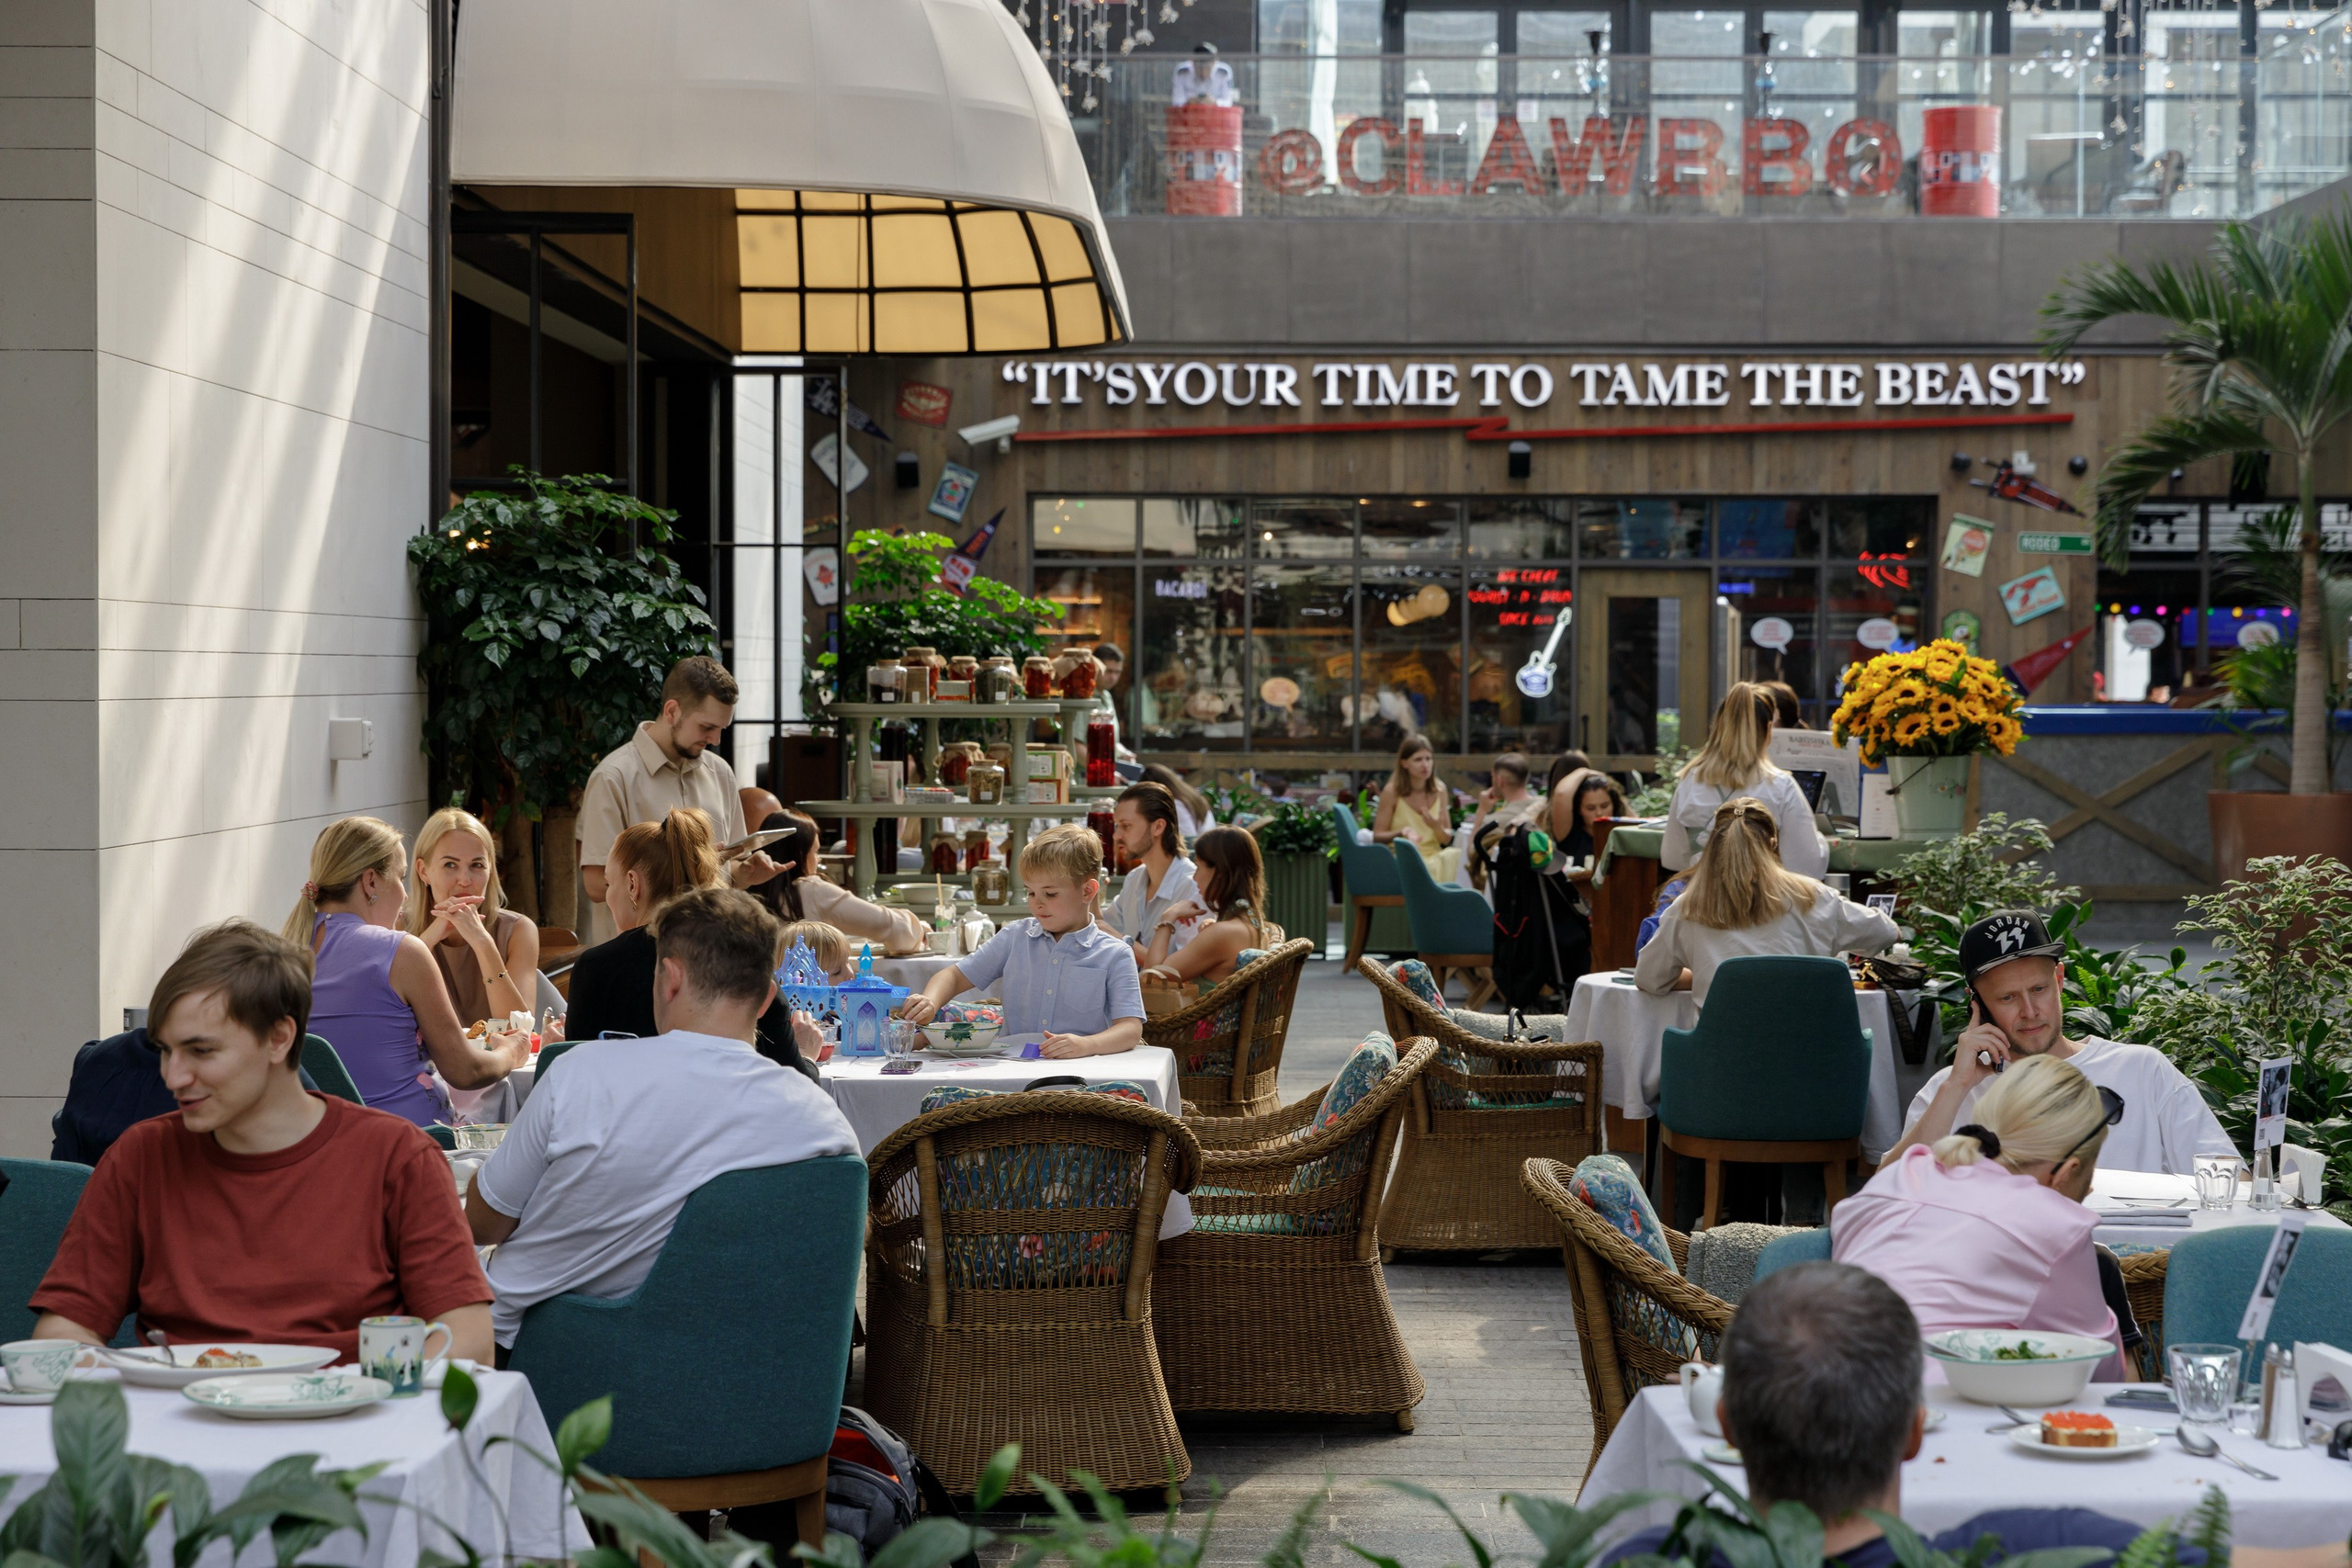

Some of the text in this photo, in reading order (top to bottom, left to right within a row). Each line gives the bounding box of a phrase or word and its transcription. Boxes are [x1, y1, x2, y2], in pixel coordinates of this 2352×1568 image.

[1312, 362, 1462, 407] TIME
[1470, 362, 1555, 408] TO
[1569, 362, 1730, 407] TAME
[1739, 362, 1866, 407] THE
[1984, 916, 2030, 940] JORDAN
